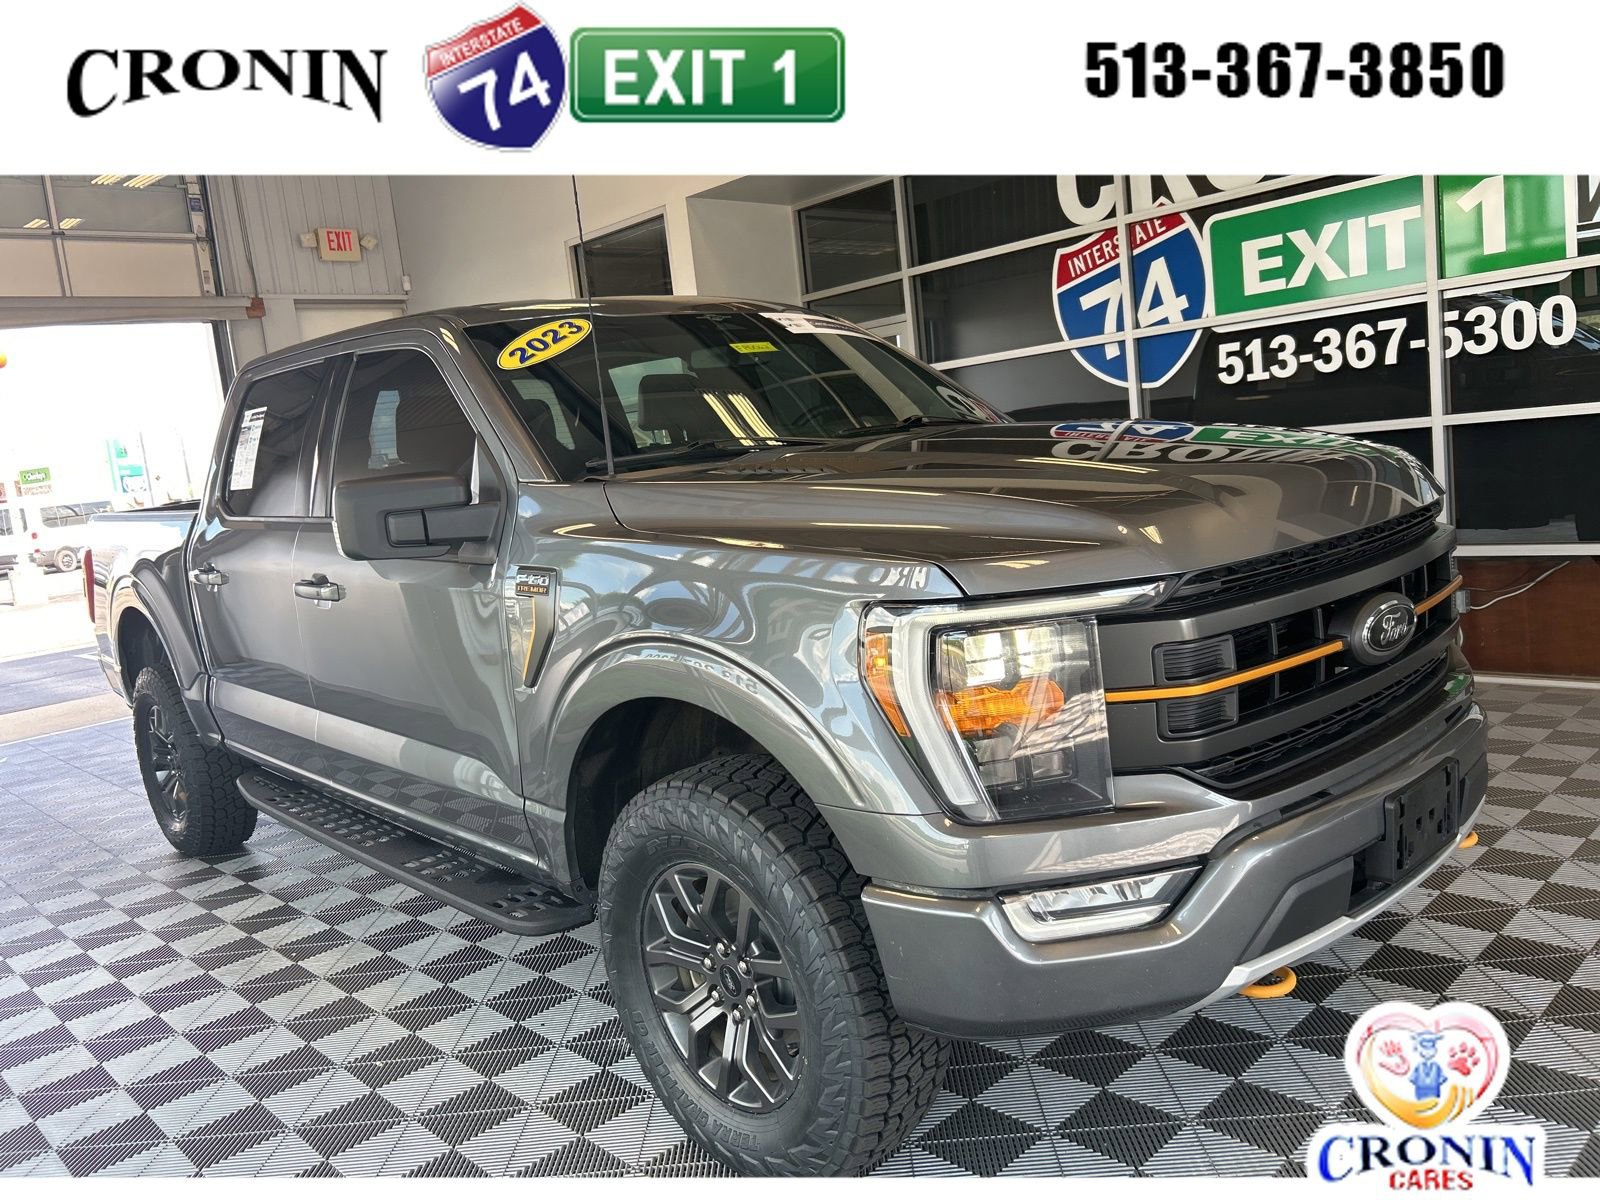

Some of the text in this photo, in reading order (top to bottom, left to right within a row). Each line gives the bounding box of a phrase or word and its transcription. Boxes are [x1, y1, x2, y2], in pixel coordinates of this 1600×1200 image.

[326, 230, 353, 252] EXIT
[1067, 218, 1167, 278] INTERSATE
[1241, 175, 1508, 297] EXIT 1
[1079, 256, 1189, 361] 74
[508, 321, 583, 365] 2023
[1217, 294, 1577, 386] 513-367-5300
[1380, 608, 1414, 646] Ford
